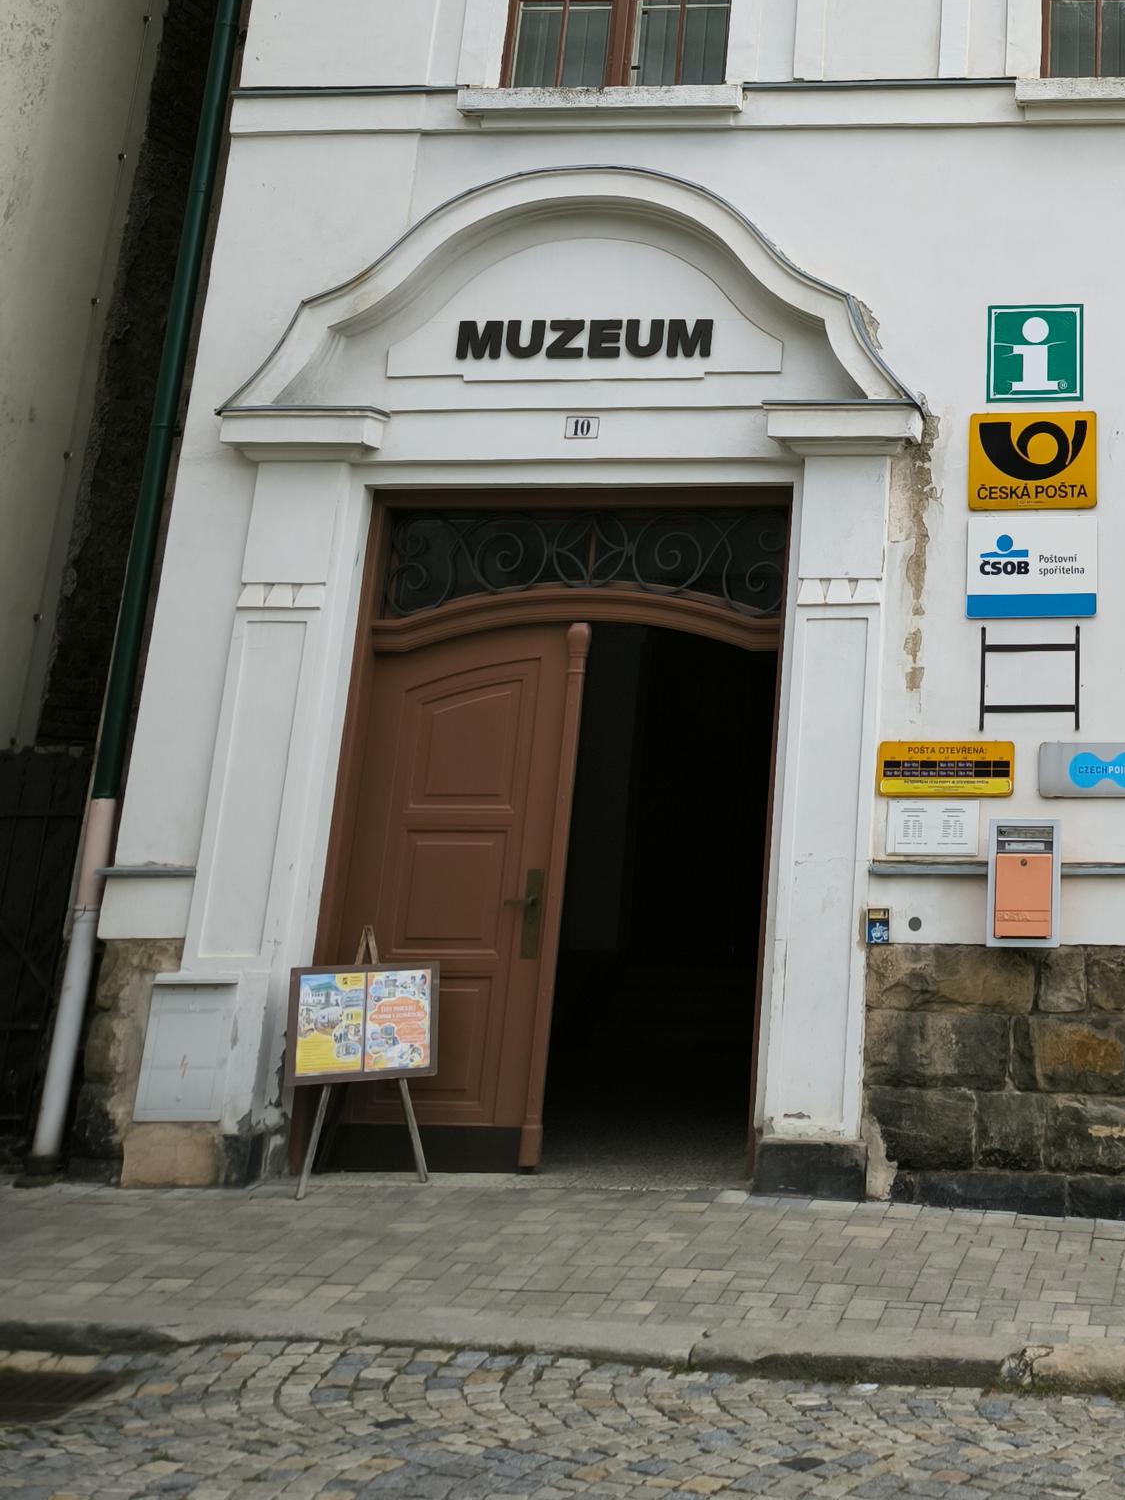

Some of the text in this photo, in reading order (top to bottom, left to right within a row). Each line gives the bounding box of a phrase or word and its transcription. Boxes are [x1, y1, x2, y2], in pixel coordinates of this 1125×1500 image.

[456, 319, 714, 360] MUZEUM
[573, 419, 591, 436] 10
[977, 482, 1088, 500] ČESKÁ POŠTA
[1038, 554, 1078, 563] Poštovní
[979, 559, 1030, 575] ČSOB
[1038, 566, 1085, 576] spořitelna
[908, 745, 987, 755] POŠTA OTEVŘENA:
